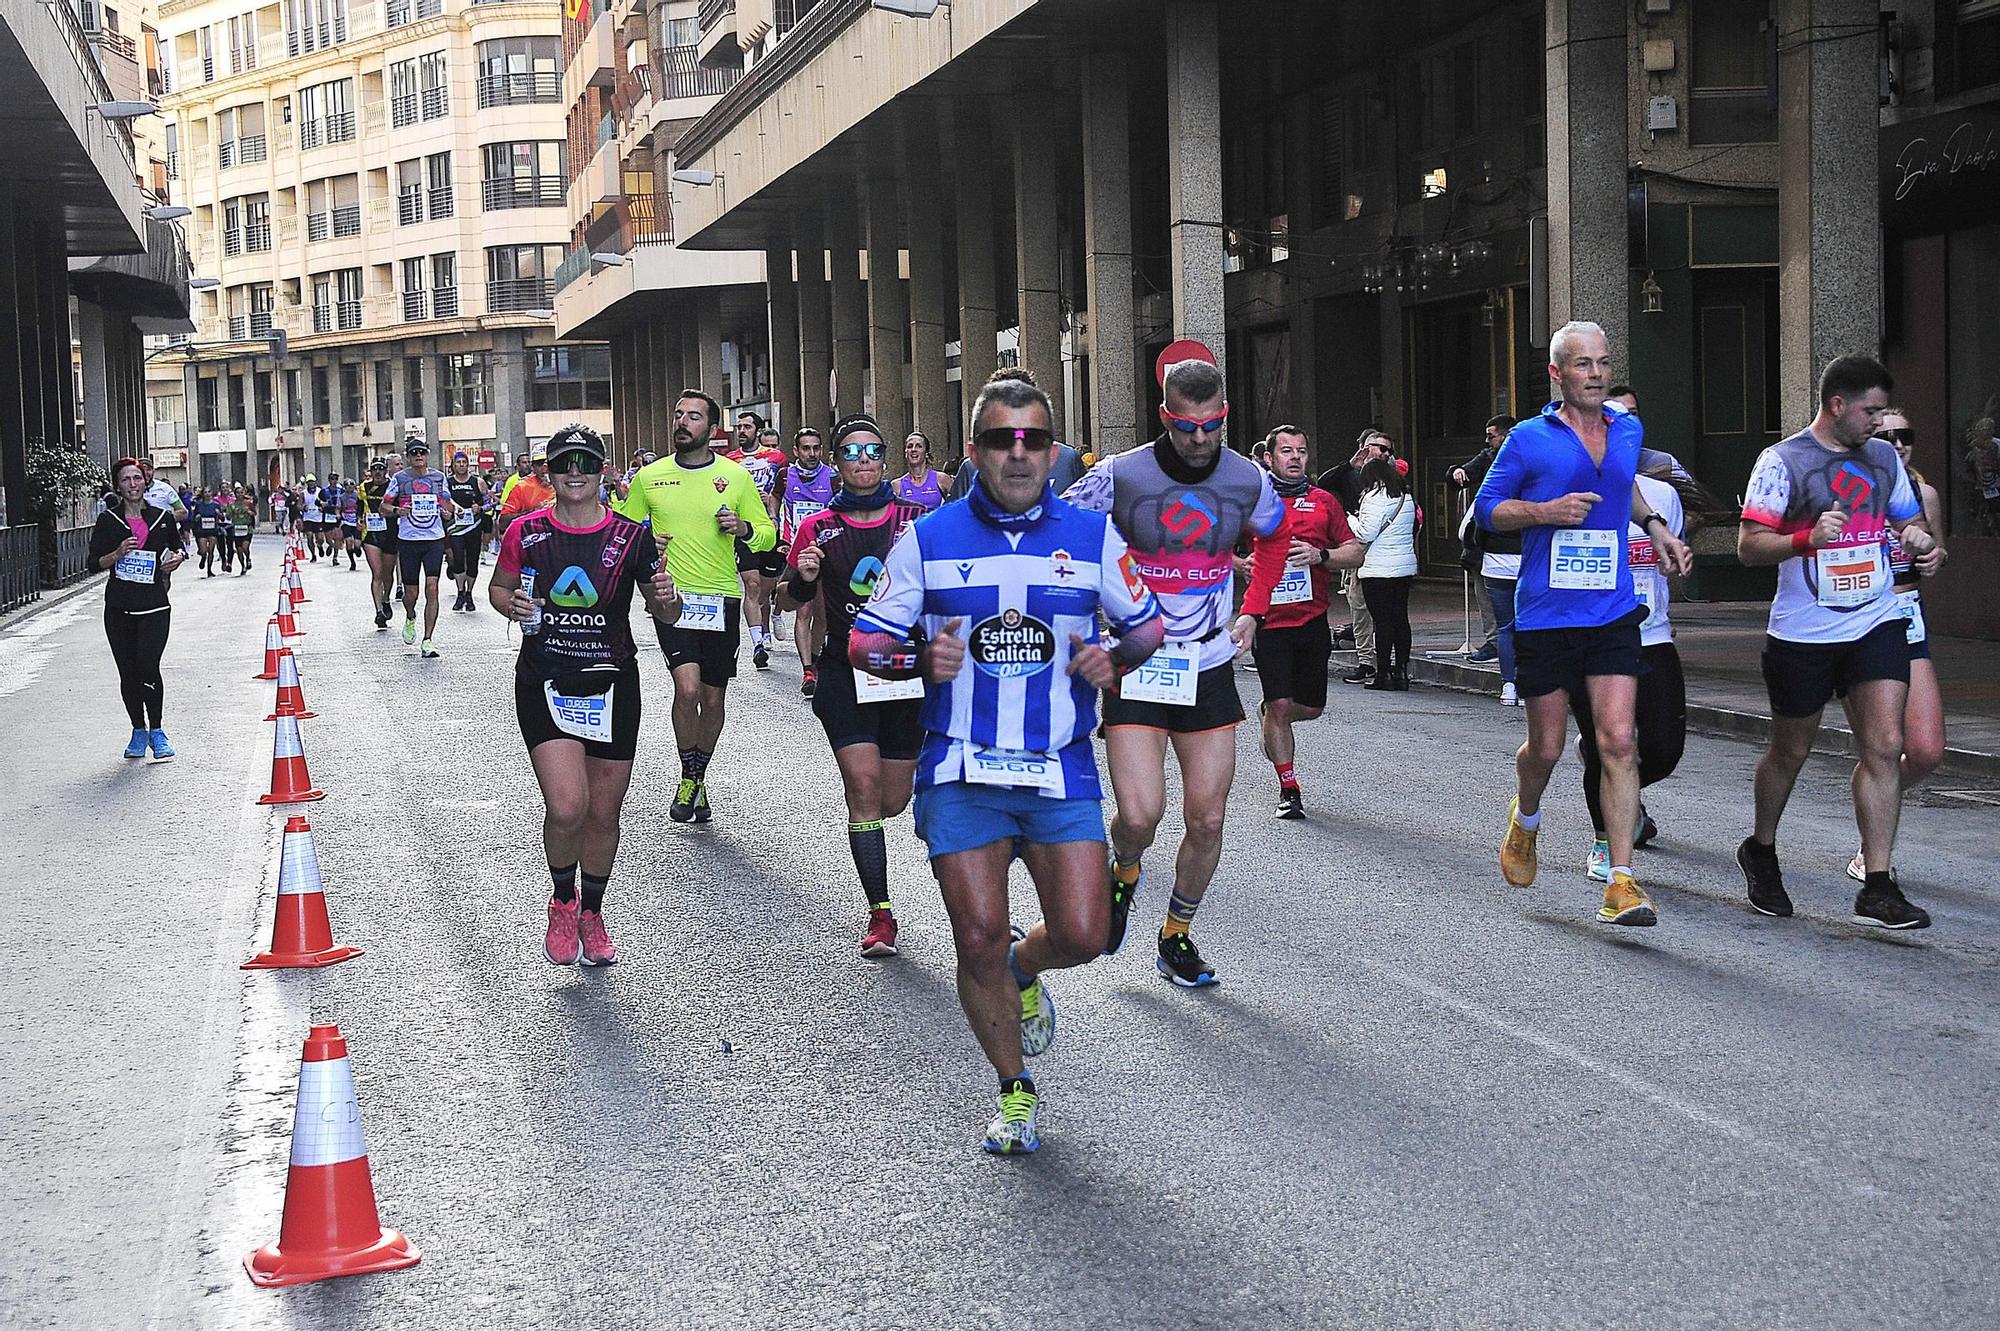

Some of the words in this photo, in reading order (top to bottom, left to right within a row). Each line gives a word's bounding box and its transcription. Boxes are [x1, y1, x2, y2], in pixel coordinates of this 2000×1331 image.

[1555, 558, 1612, 574] 2095
[1831, 574, 1871, 592] 1318
[682, 610, 717, 622] 1777
[979, 627, 1045, 645] Estrella
[982, 646, 1042, 663] Galicia
[1138, 669, 1181, 688] 1751
[564, 699, 590, 709] LOURDES
[556, 707, 601, 727] 1536
[976, 759, 1047, 775] 1560
